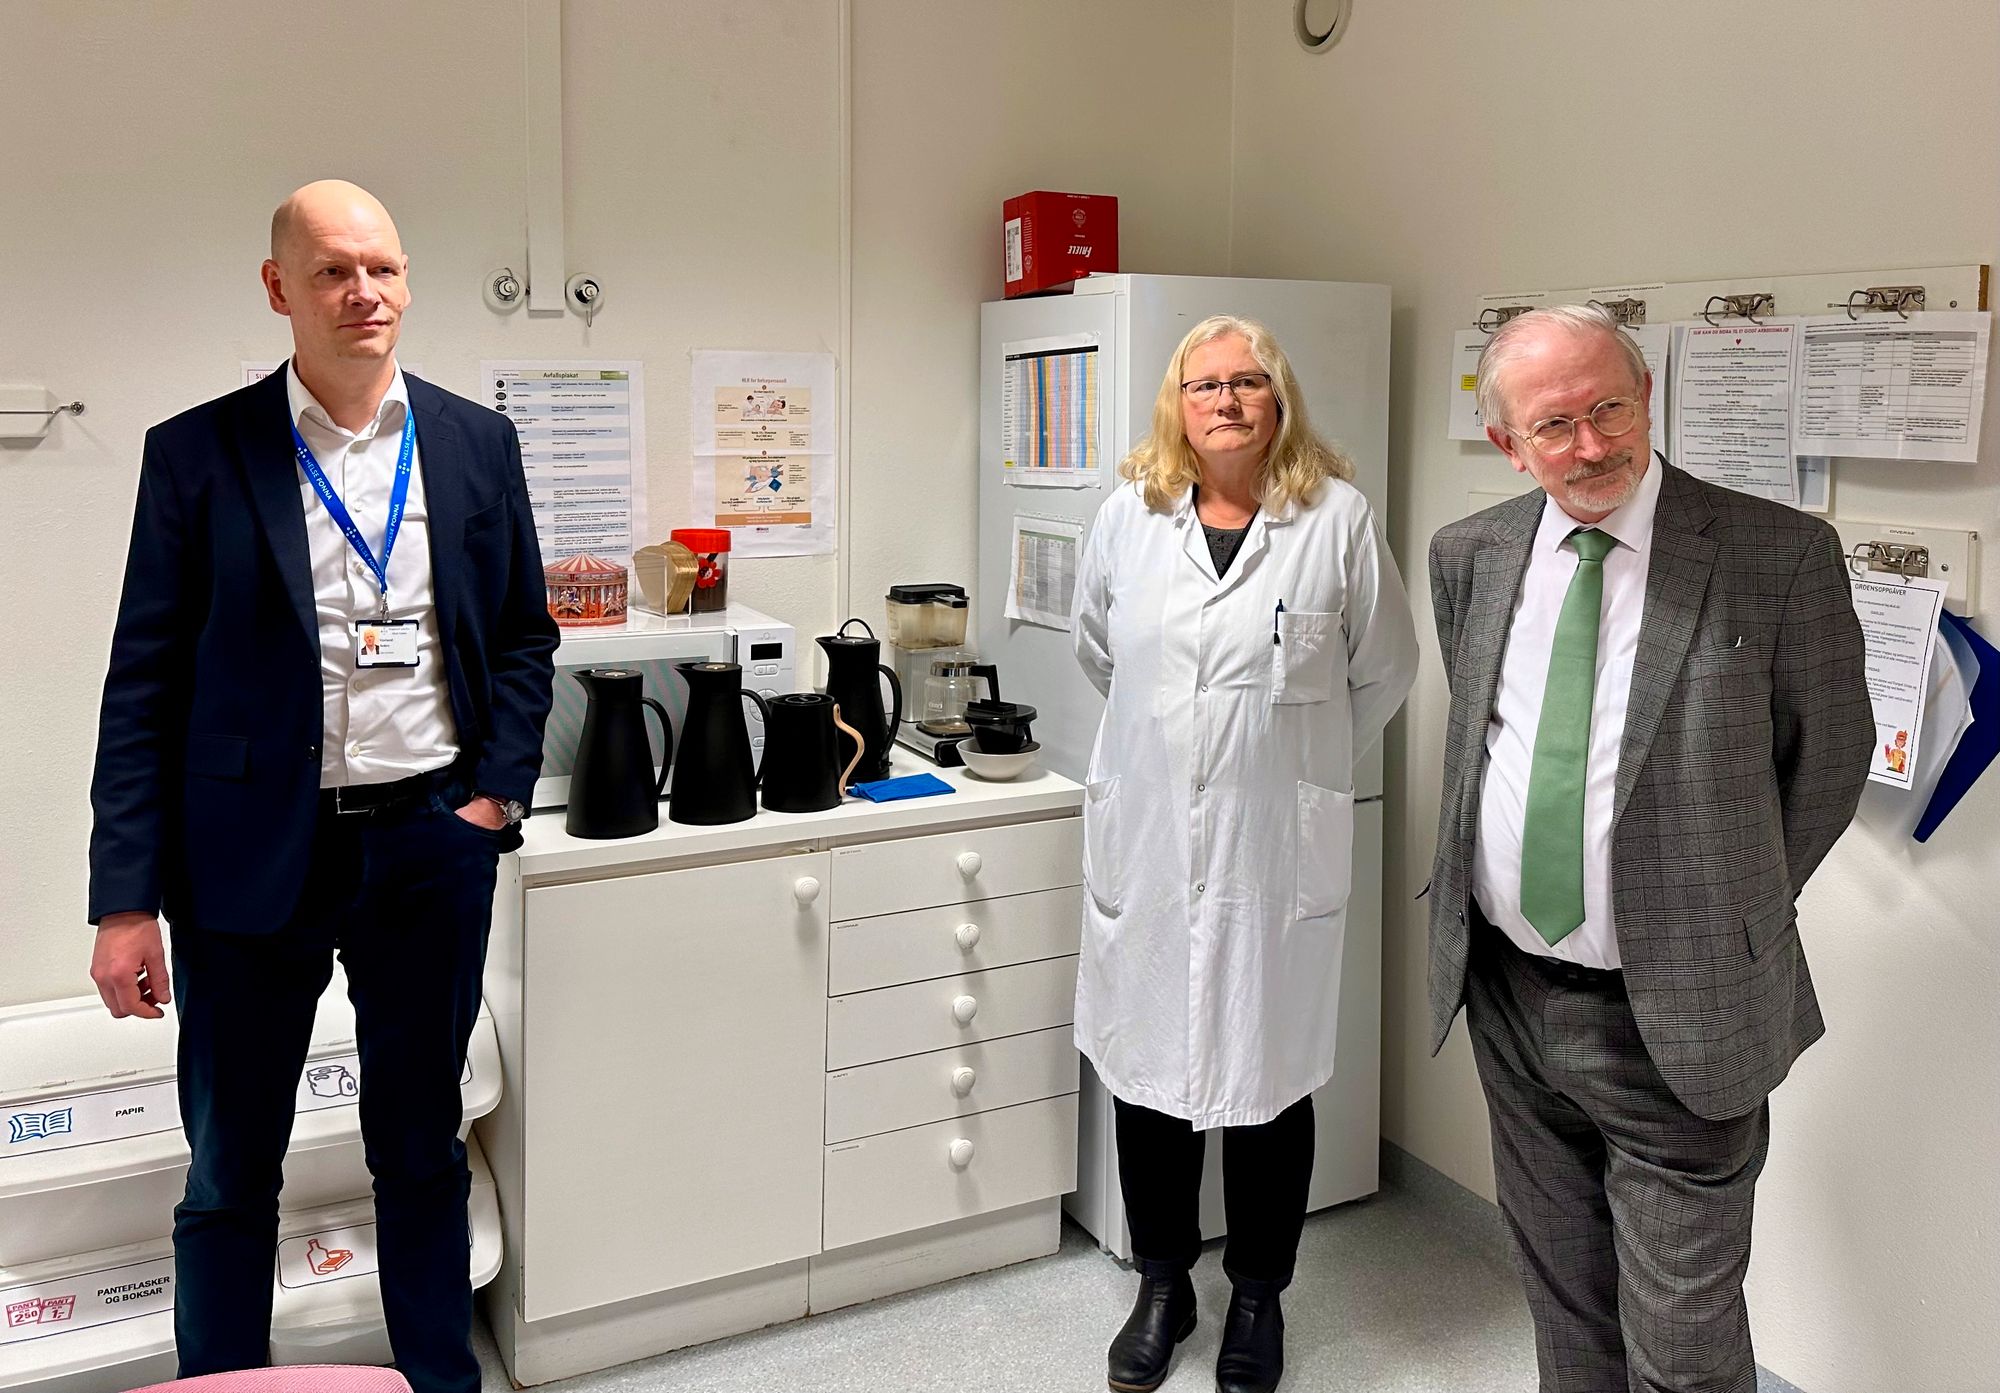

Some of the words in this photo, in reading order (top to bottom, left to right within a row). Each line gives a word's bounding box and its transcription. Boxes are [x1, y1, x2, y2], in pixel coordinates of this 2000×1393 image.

[1067, 245, 1092, 258] FRIELE
[305, 459, 320, 478] HELSE
[316, 477, 333, 500] FONNA
[390, 503, 400, 527] FONNA
[1854, 583, 1907, 596] ORDENSOPPGÅVER
[115, 1106, 145, 1118] PAPIR
[97, 1276, 171, 1297] PANTEFLASKER
[105, 1295, 120, 1305] OG
[122, 1287, 163, 1302] BOKSAR
[12, 1302, 35, 1310] PANT
[14, 1310, 38, 1324] 250
